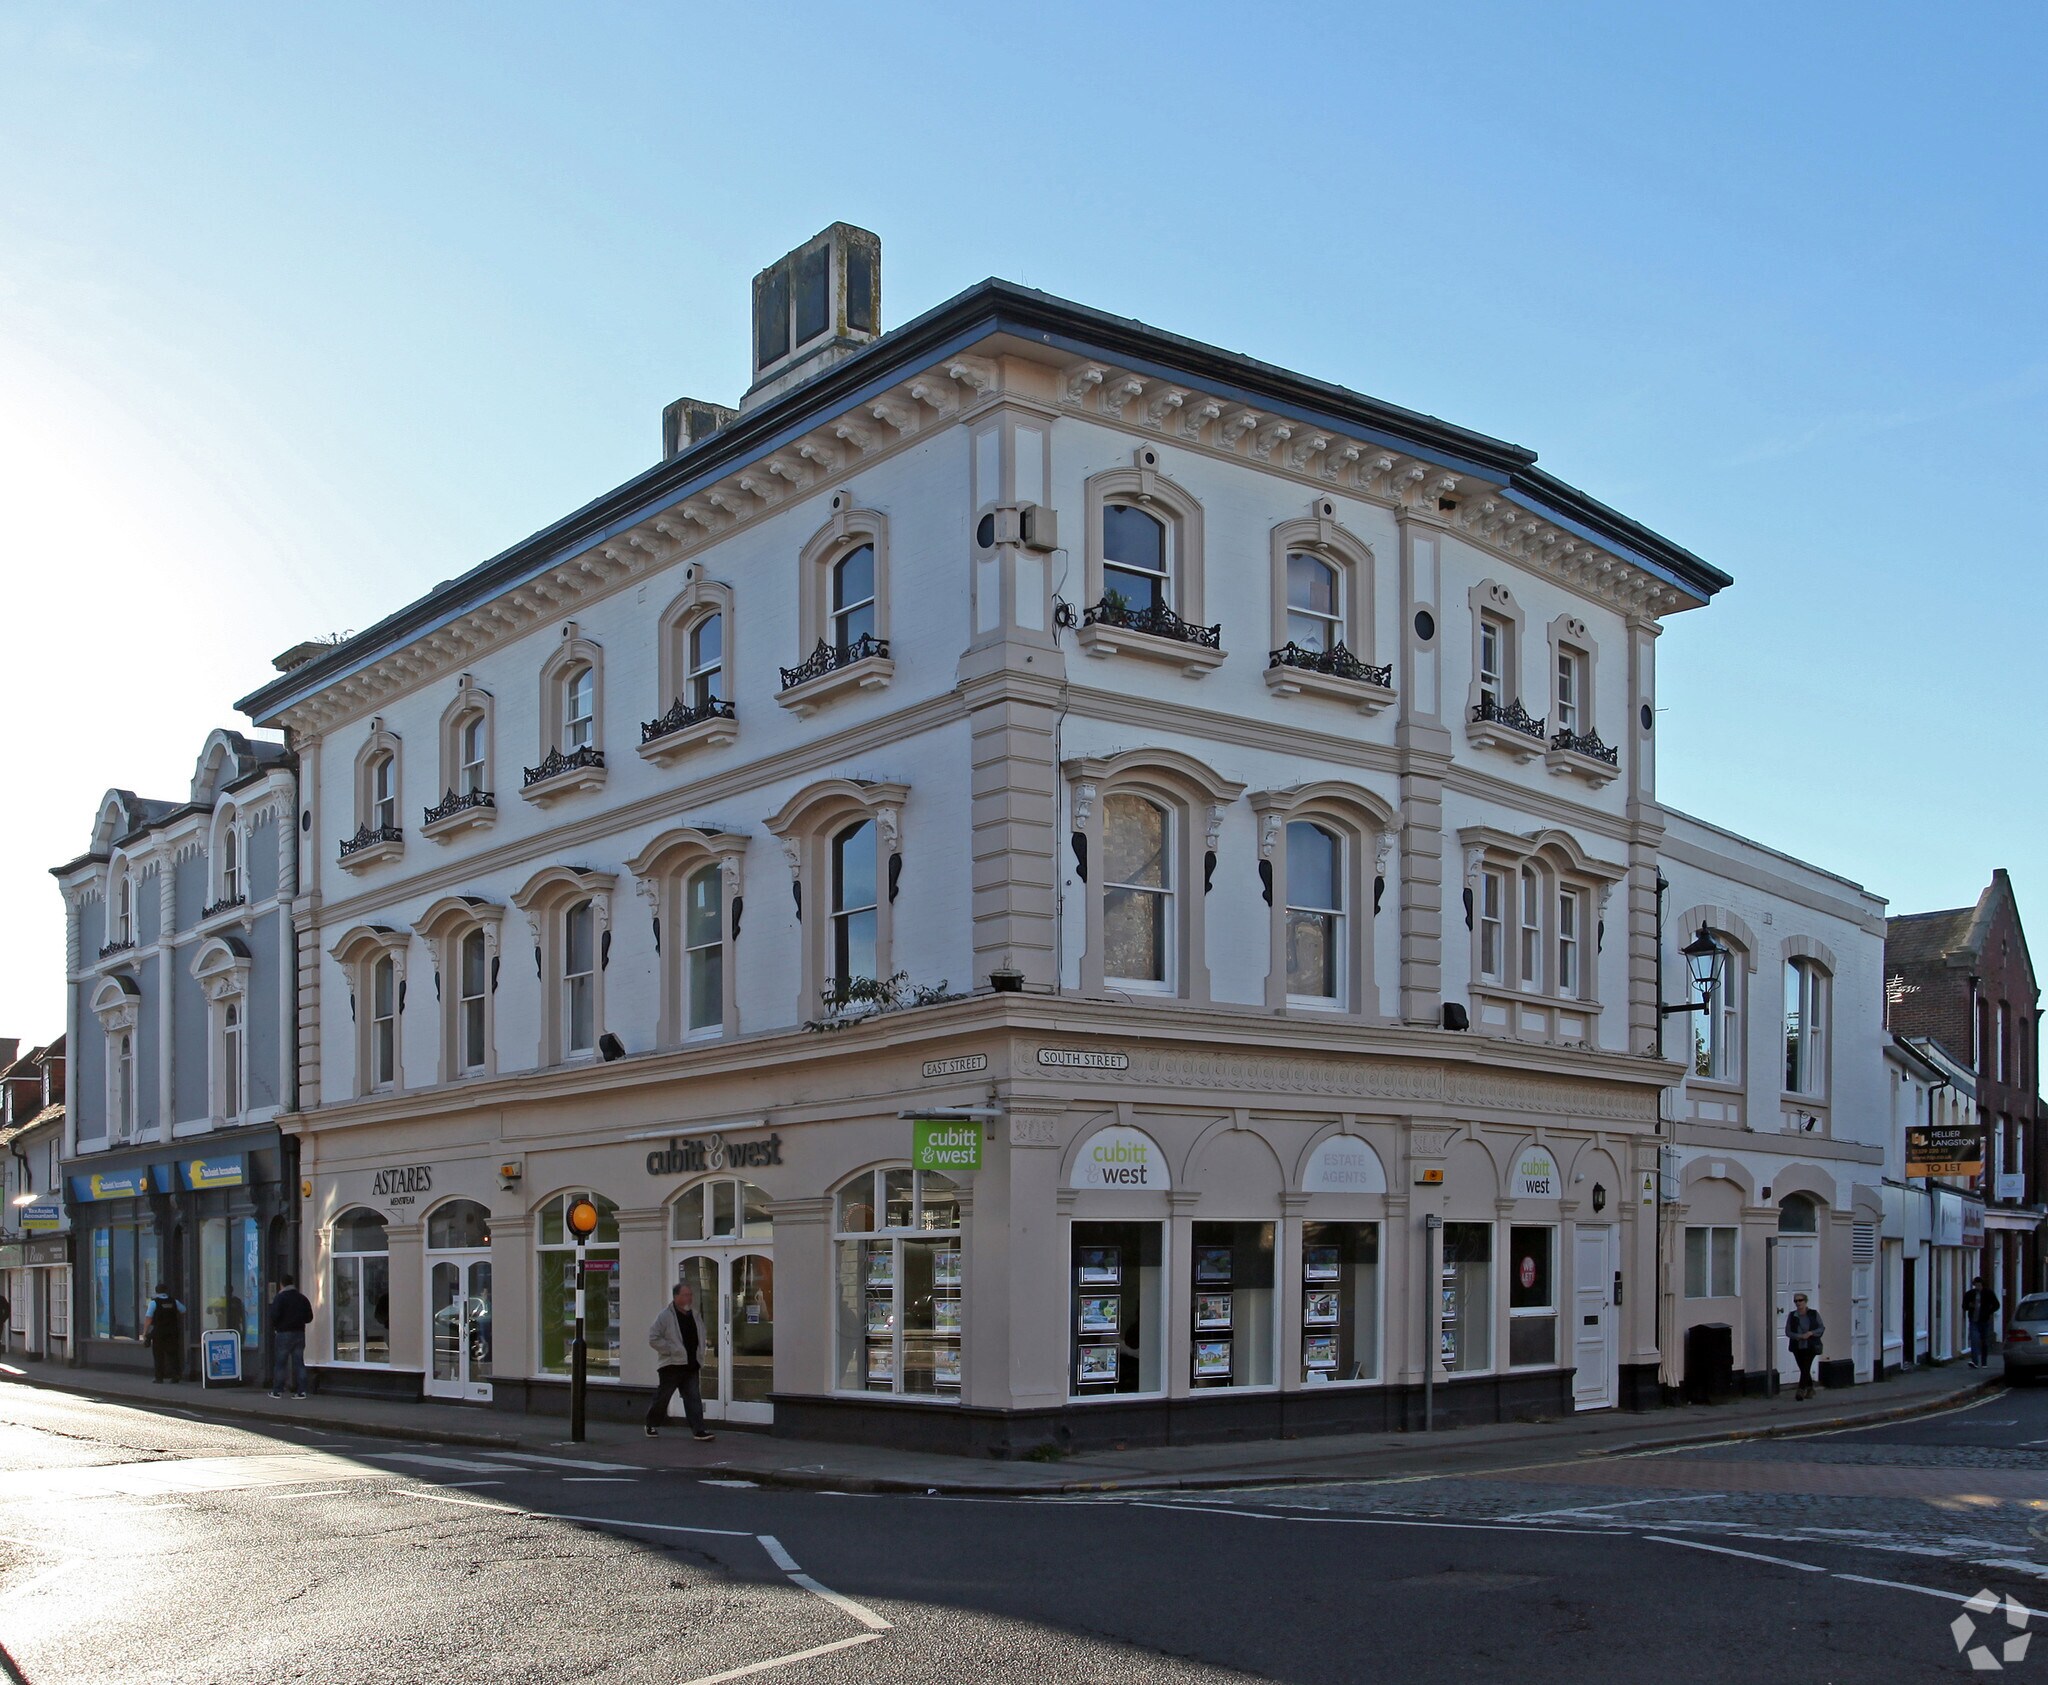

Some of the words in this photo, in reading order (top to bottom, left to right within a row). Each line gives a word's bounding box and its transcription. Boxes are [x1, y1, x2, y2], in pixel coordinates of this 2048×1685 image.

[927, 1062, 947, 1075] EAST
[949, 1057, 983, 1071] STREET
[1044, 1051, 1080, 1065] SOUTH
[1084, 1054, 1123, 1067] STREET
[928, 1128, 977, 1146] cubitt
[1931, 1130, 1960, 1138] HELLIER
[1931, 1139, 1975, 1147] LANGSTON
[646, 1138, 707, 1175] cubitt
[705, 1133, 724, 1170] &
[728, 1132, 782, 1168] west
[921, 1146, 934, 1164] &
[936, 1149, 976, 1164] west
[1092, 1139, 1147, 1163] cubitt
[1324, 1153, 1365, 1167] ESTATE
[1084, 1163, 1100, 1184] &
[1102, 1165, 1148, 1185] west
[1521, 1156, 1550, 1176] cubitt
[1926, 1164, 1941, 1172] TO
[1945, 1163, 1962, 1172] LET
[372, 1166, 432, 1195] ASTARES
[1321, 1170, 1368, 1183] AGENTS
[1526, 1177, 1550, 1194] west
